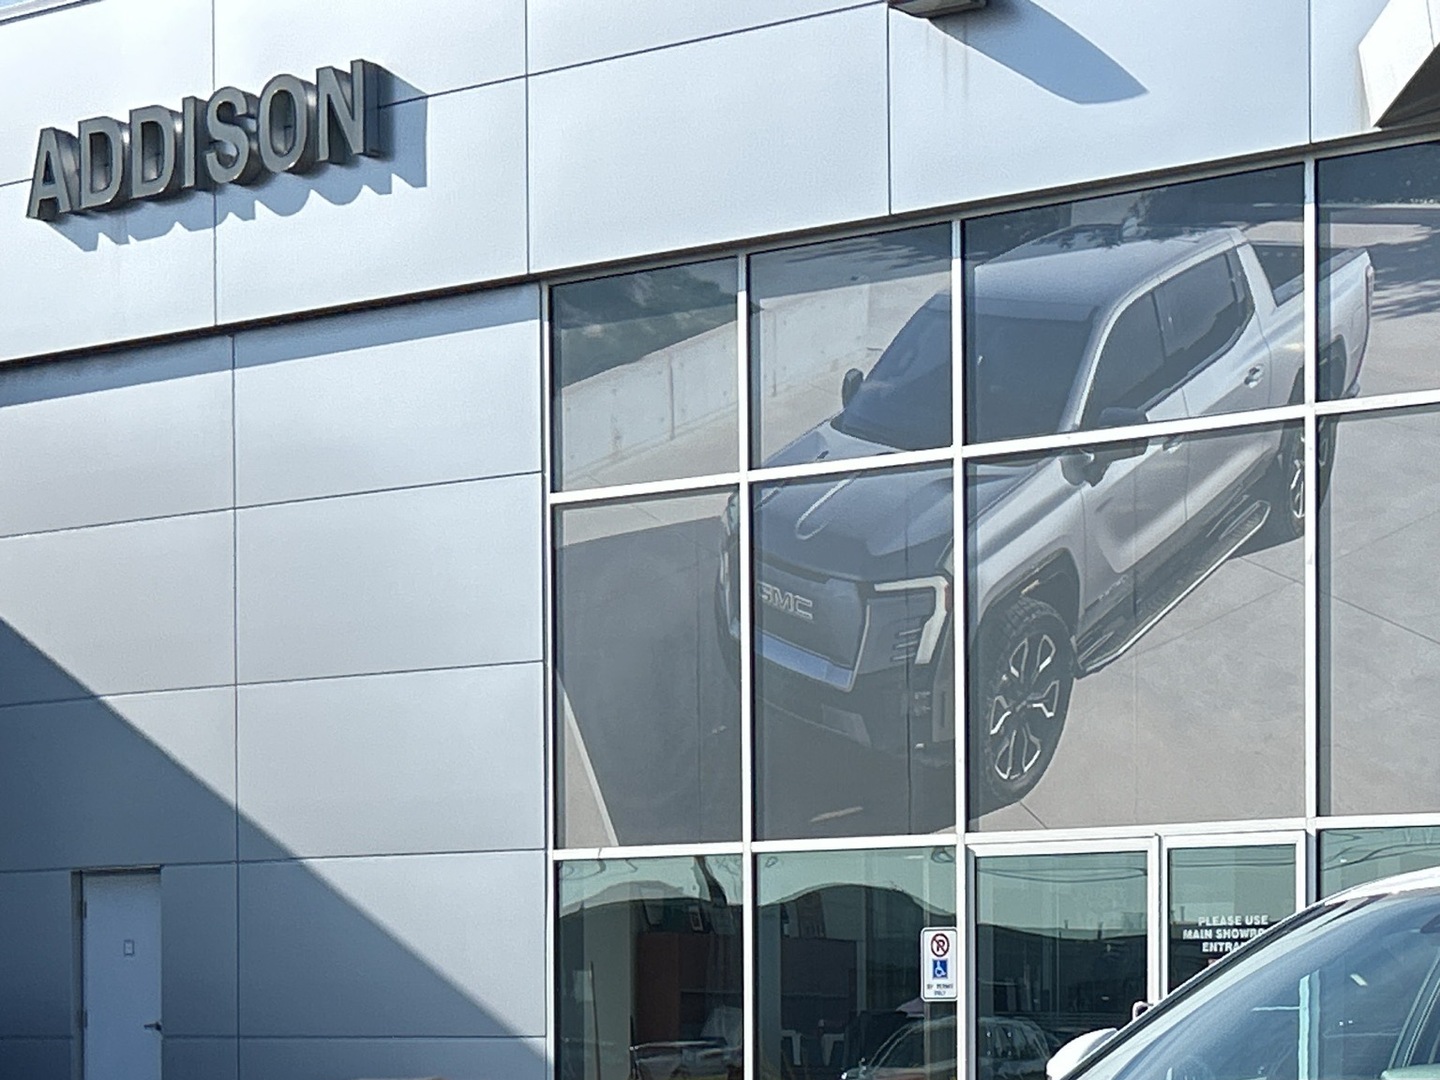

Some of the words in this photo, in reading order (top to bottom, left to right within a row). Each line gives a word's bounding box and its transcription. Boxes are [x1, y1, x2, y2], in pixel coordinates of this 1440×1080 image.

[26, 59, 382, 220] ADDISON
[757, 581, 813, 620] GMC
[1198, 915, 1242, 927] PLEASE
[1245, 914, 1269, 926] USE
[1183, 929, 1213, 940] MAIN
[1216, 928, 1265, 939] SHOWR
[1202, 942, 1246, 953] ENTRA
